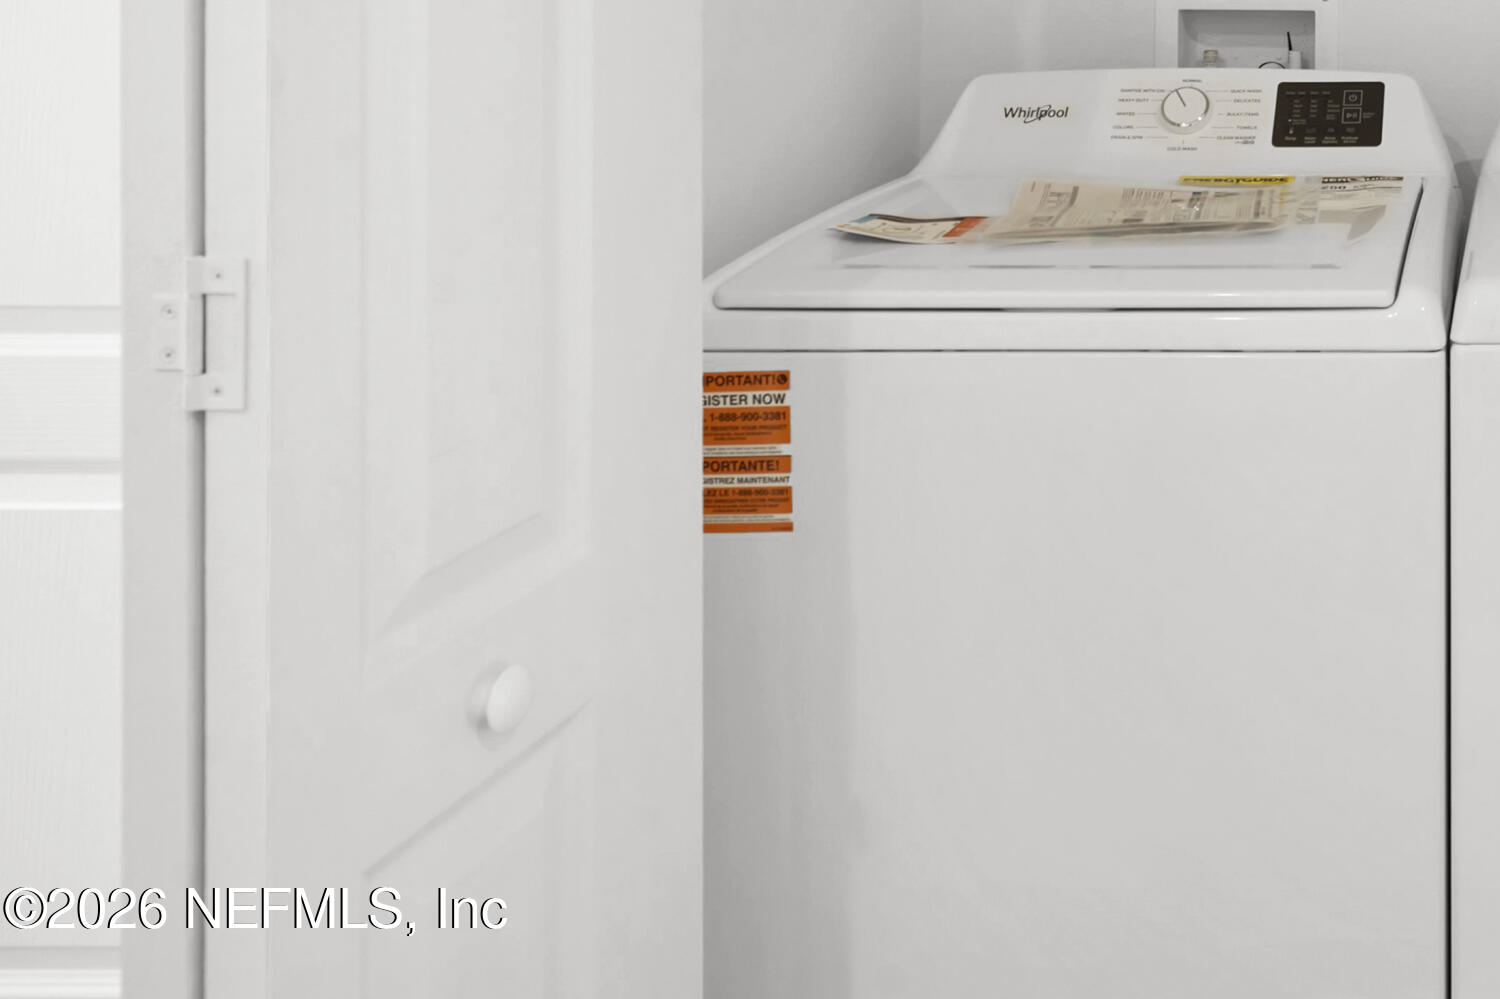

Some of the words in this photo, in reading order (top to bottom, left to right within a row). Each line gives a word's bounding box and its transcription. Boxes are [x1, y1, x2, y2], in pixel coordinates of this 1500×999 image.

[1003, 104, 1069, 123] Whirlpool
[703, 374, 776, 387] PORTANT!
[702, 394, 748, 406] GISTER
[752, 393, 786, 405] NOW
[710, 411, 787, 422] 1-888-900-3381
[703, 459, 780, 472] PORTANTE!
[736, 476, 790, 484] MAINTENANT
